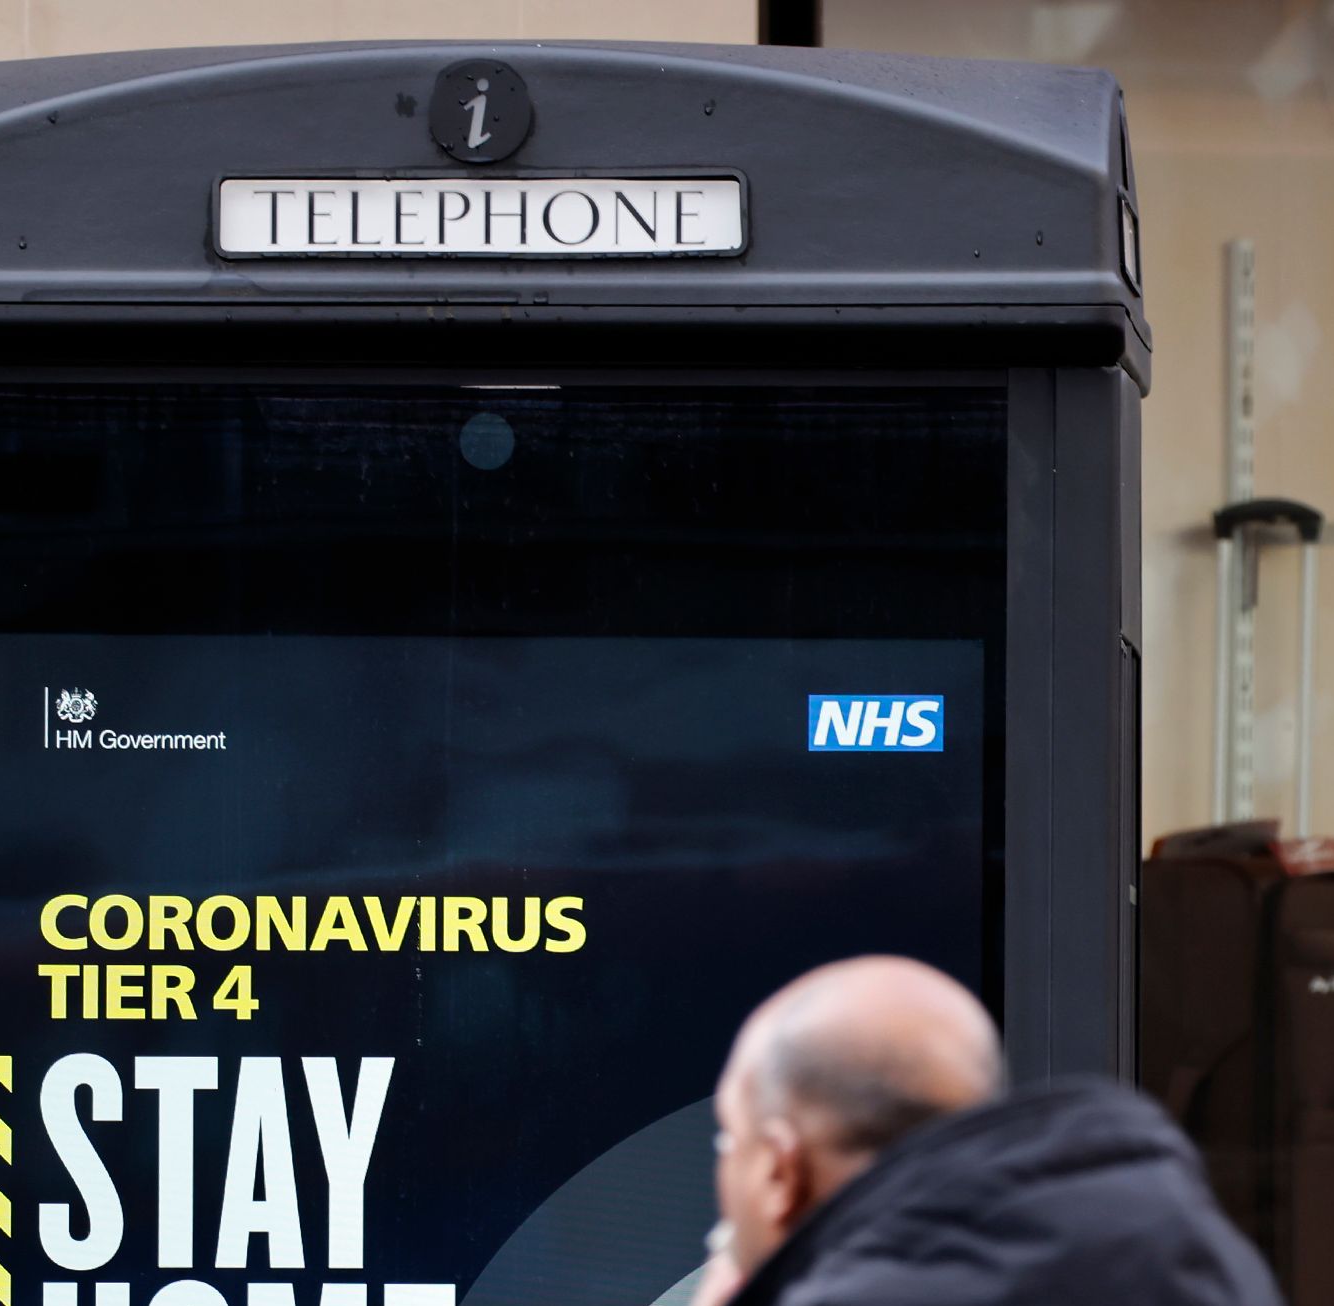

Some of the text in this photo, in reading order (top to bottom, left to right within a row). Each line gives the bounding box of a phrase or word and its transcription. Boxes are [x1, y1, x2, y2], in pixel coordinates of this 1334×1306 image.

[254, 190, 707, 245] TELEPHONE
[57, 730, 226, 749] HM Government
[814, 700, 939, 746] NHS
[41, 895, 586, 952] CORONAVIRUS
[38, 965, 259, 1019] TIER 4
[39, 1053, 395, 1270] STAY
